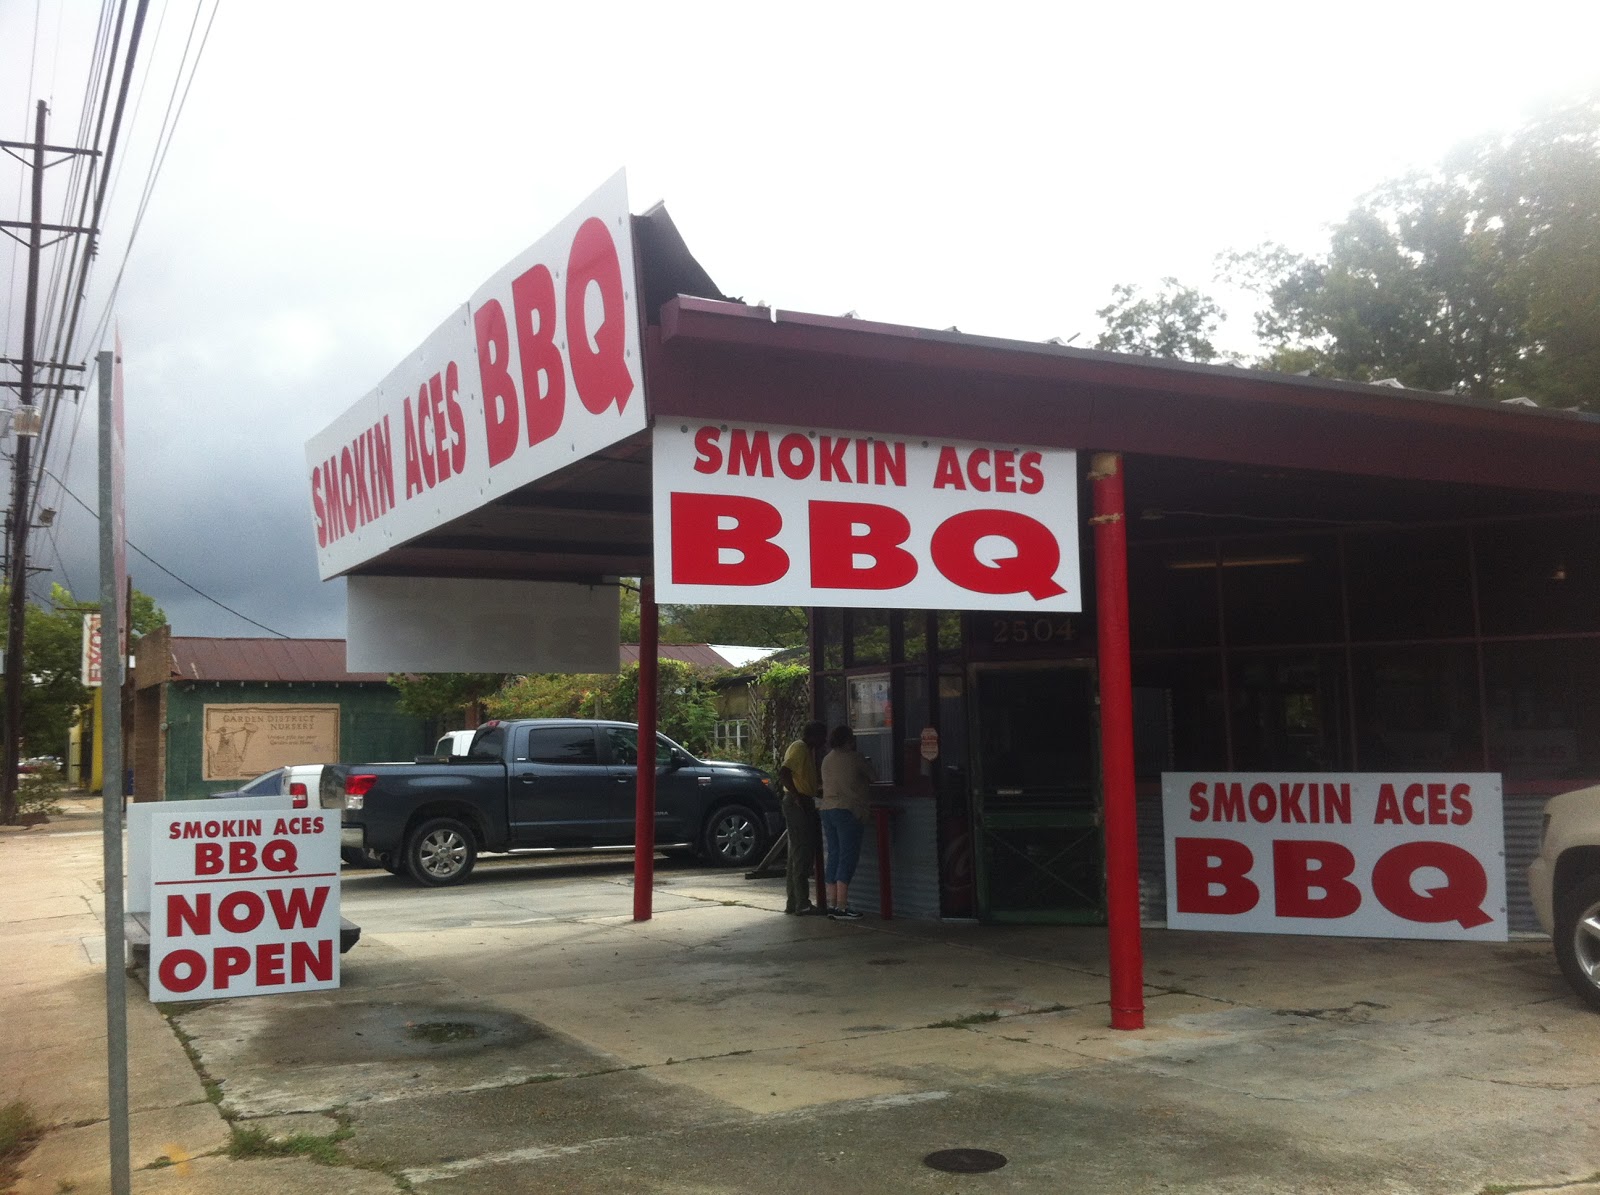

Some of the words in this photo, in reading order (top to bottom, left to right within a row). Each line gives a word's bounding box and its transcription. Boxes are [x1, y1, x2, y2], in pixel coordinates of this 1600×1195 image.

[474, 216, 634, 471] BBQ
[312, 415, 395, 549] SMOKIN
[404, 360, 466, 500] ACES
[695, 427, 906, 487] SMOKIN
[934, 447, 1045, 495] ACES
[671, 491, 1067, 601] BBQ
[993, 619, 1075, 642] 2504
[270, 723, 315, 731] NURSERY
[169, 820, 262, 840] SMOKIN
[273, 817, 325, 836] ACES
[1190, 782, 1352, 824] SMOKIN
[1374, 783, 1473, 826] ACES
[195, 839, 298, 876] BBQ
[1176, 837, 1493, 930] BBQ
[167, 886, 331, 937] NOW
[159, 940, 333, 993] OPEN
